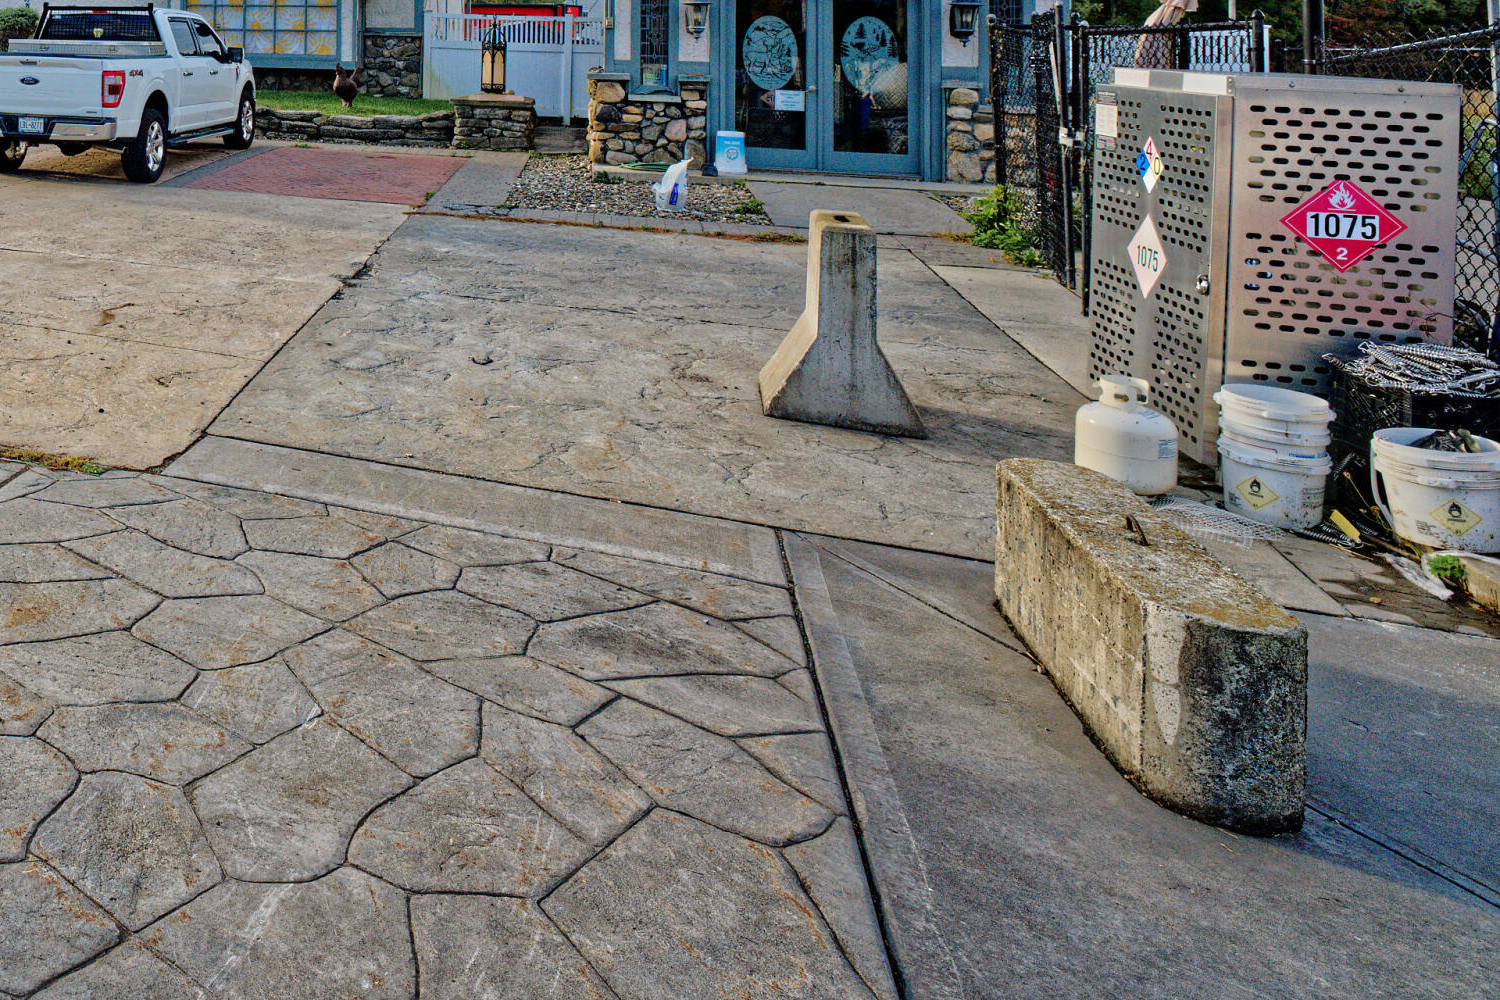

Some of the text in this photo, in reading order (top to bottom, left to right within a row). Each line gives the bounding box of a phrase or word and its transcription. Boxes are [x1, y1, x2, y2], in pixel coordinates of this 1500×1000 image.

[1145, 141, 1153, 159] 4
[1138, 154, 1146, 171] 2
[1153, 156, 1161, 176] 0
[1310, 213, 1377, 239] 1075
[1137, 244, 1159, 272] 1075
[1336, 247, 1348, 260] 2
